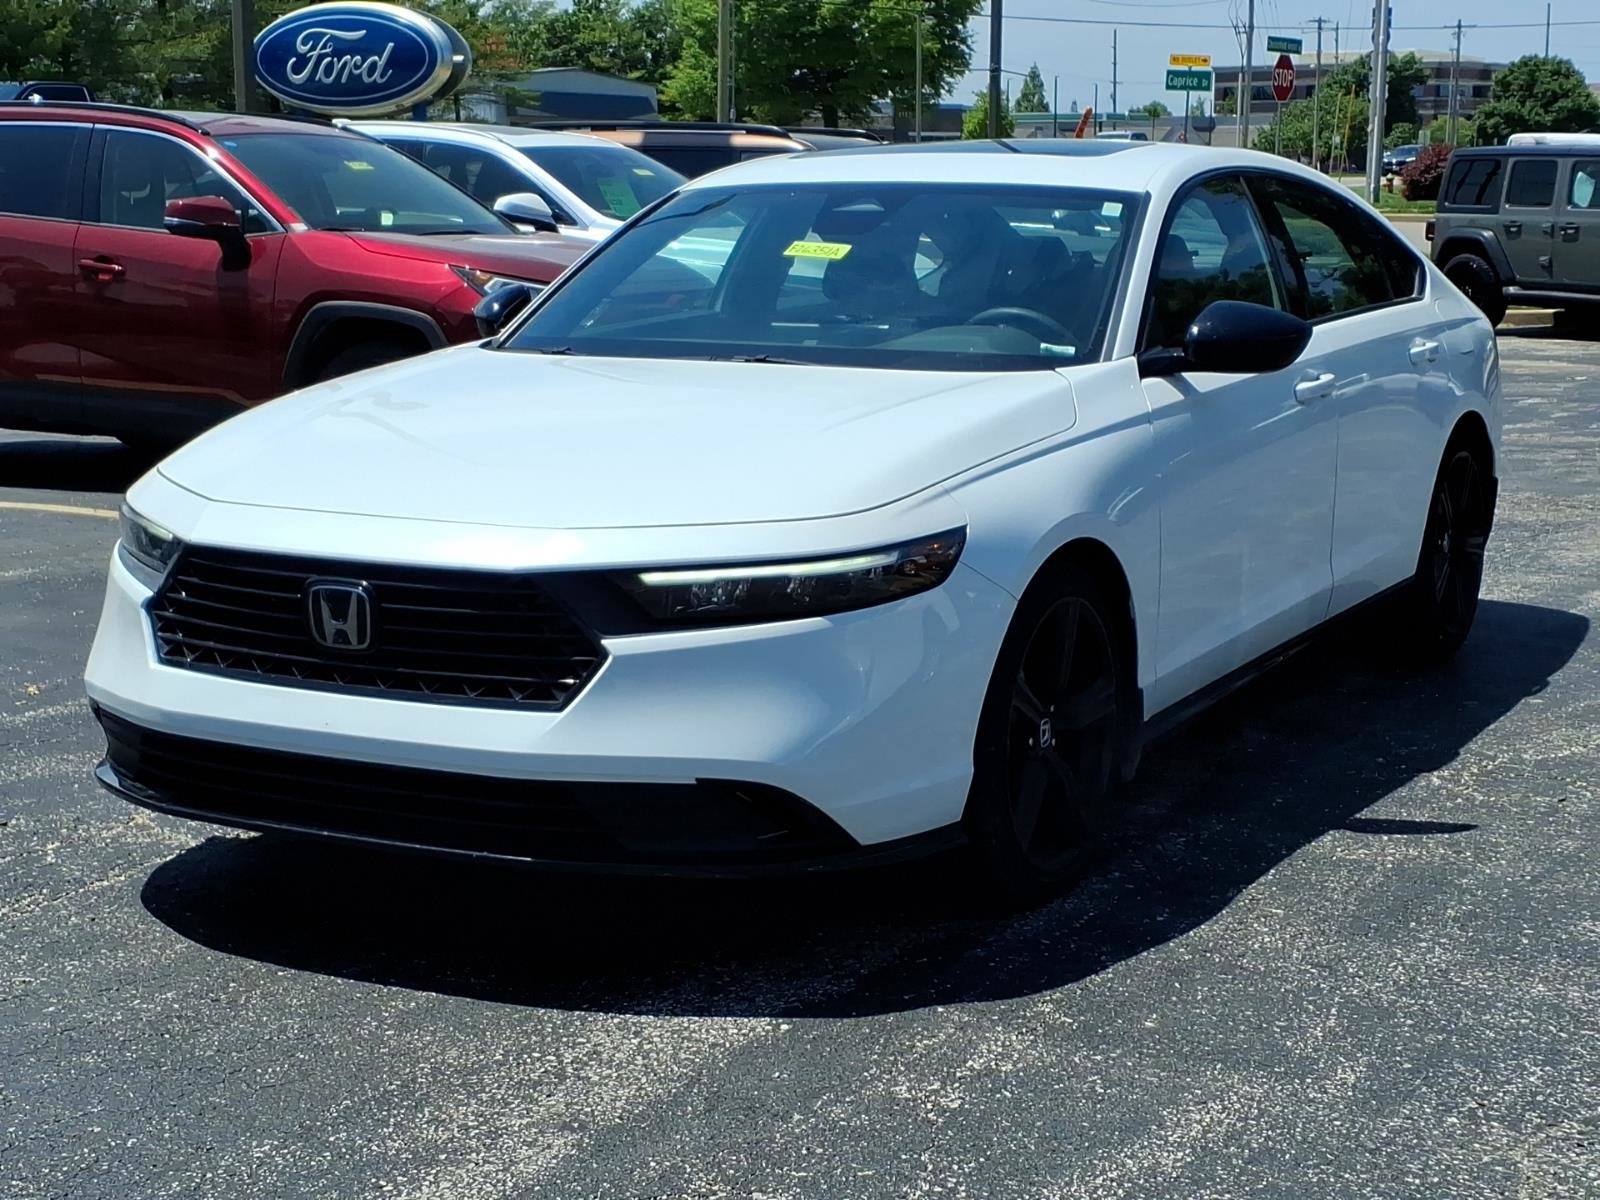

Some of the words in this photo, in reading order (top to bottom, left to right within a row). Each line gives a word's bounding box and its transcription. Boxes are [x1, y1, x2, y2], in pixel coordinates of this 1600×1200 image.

[286, 27, 395, 84] Ford
[1168, 74, 1198, 89] Caprice
[1274, 69, 1294, 88] STOP
